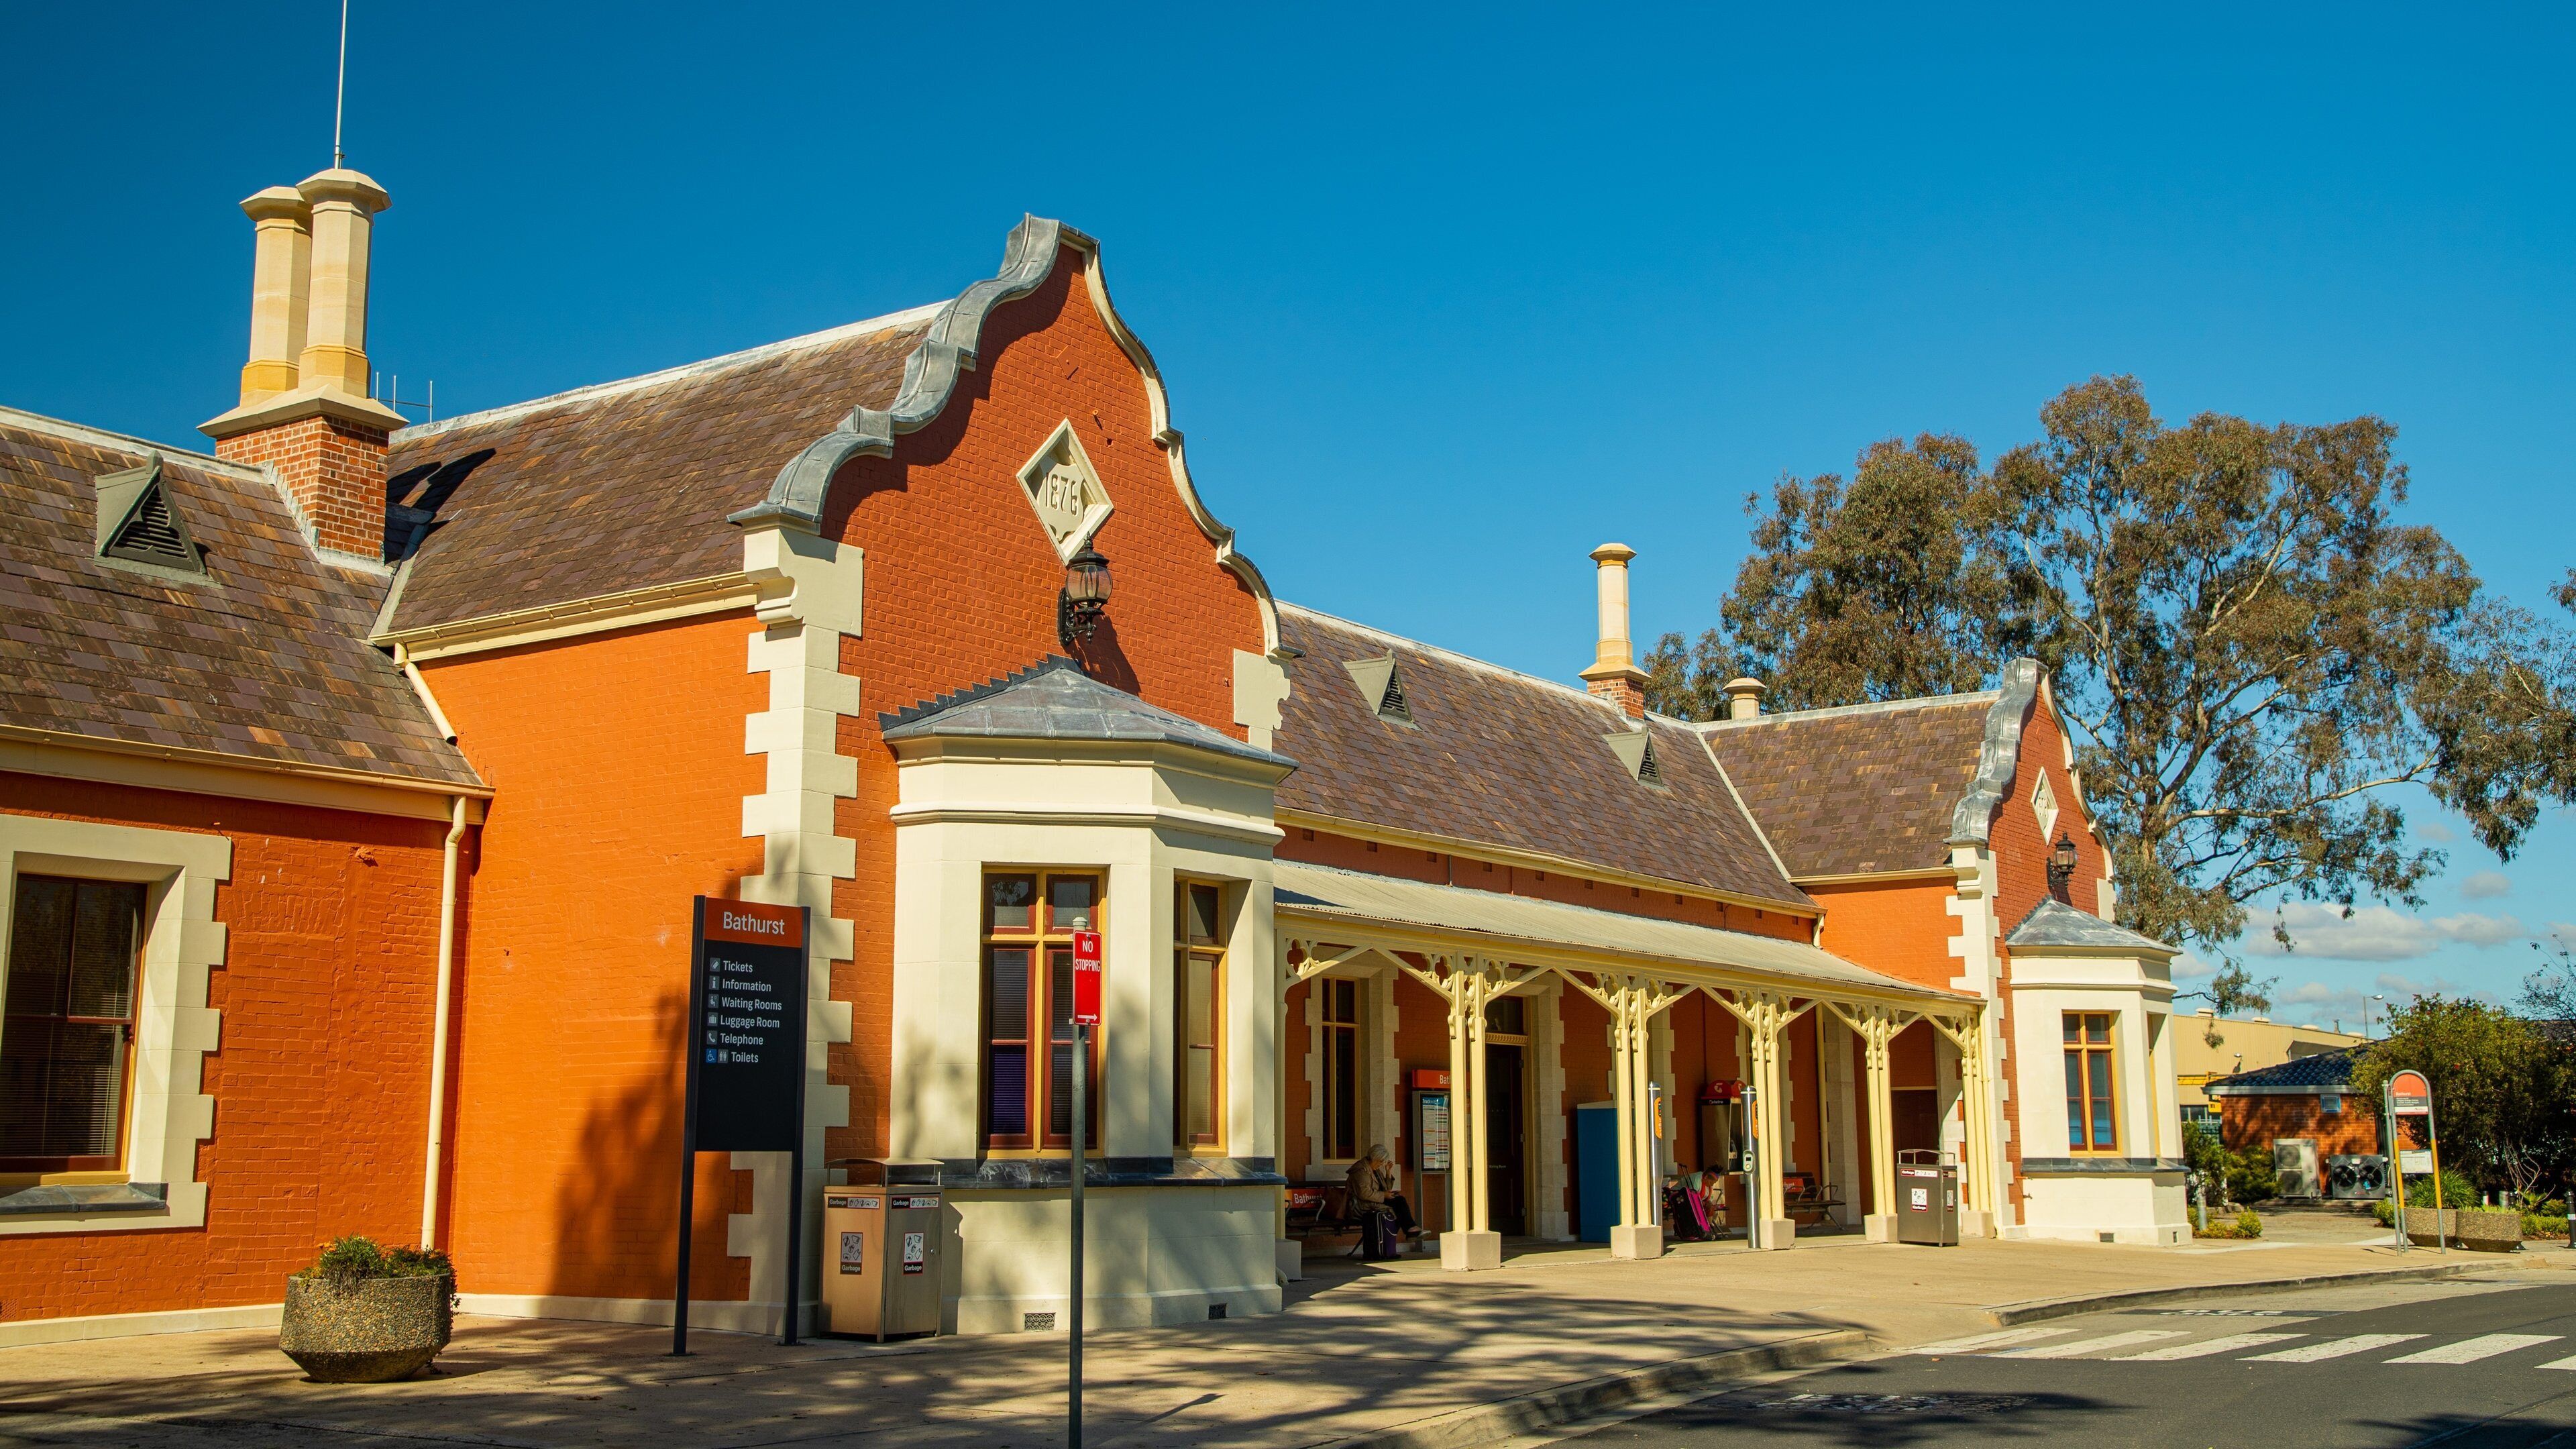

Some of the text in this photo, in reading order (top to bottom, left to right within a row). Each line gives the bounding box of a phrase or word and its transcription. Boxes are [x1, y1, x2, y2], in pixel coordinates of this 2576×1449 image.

[1044, 472, 1077, 517] 1876
[722, 911, 785, 935] Bathurst
[1082, 941, 1093, 953] NO
[722, 960, 753, 973] Tickets
[1075, 959, 1100, 972] STOPPING
[722, 979, 771, 992] Information
[721, 997, 782, 1011] Waiting Rooms
[720, 1015, 780, 1029] Luggage Room
[720, 1033, 763, 1048] Telephone
[731, 1051, 759, 1064] Toilets
[1440, 1075, 1451, 1084] Bat
[1293, 1193, 1323, 1203] Bathurst
